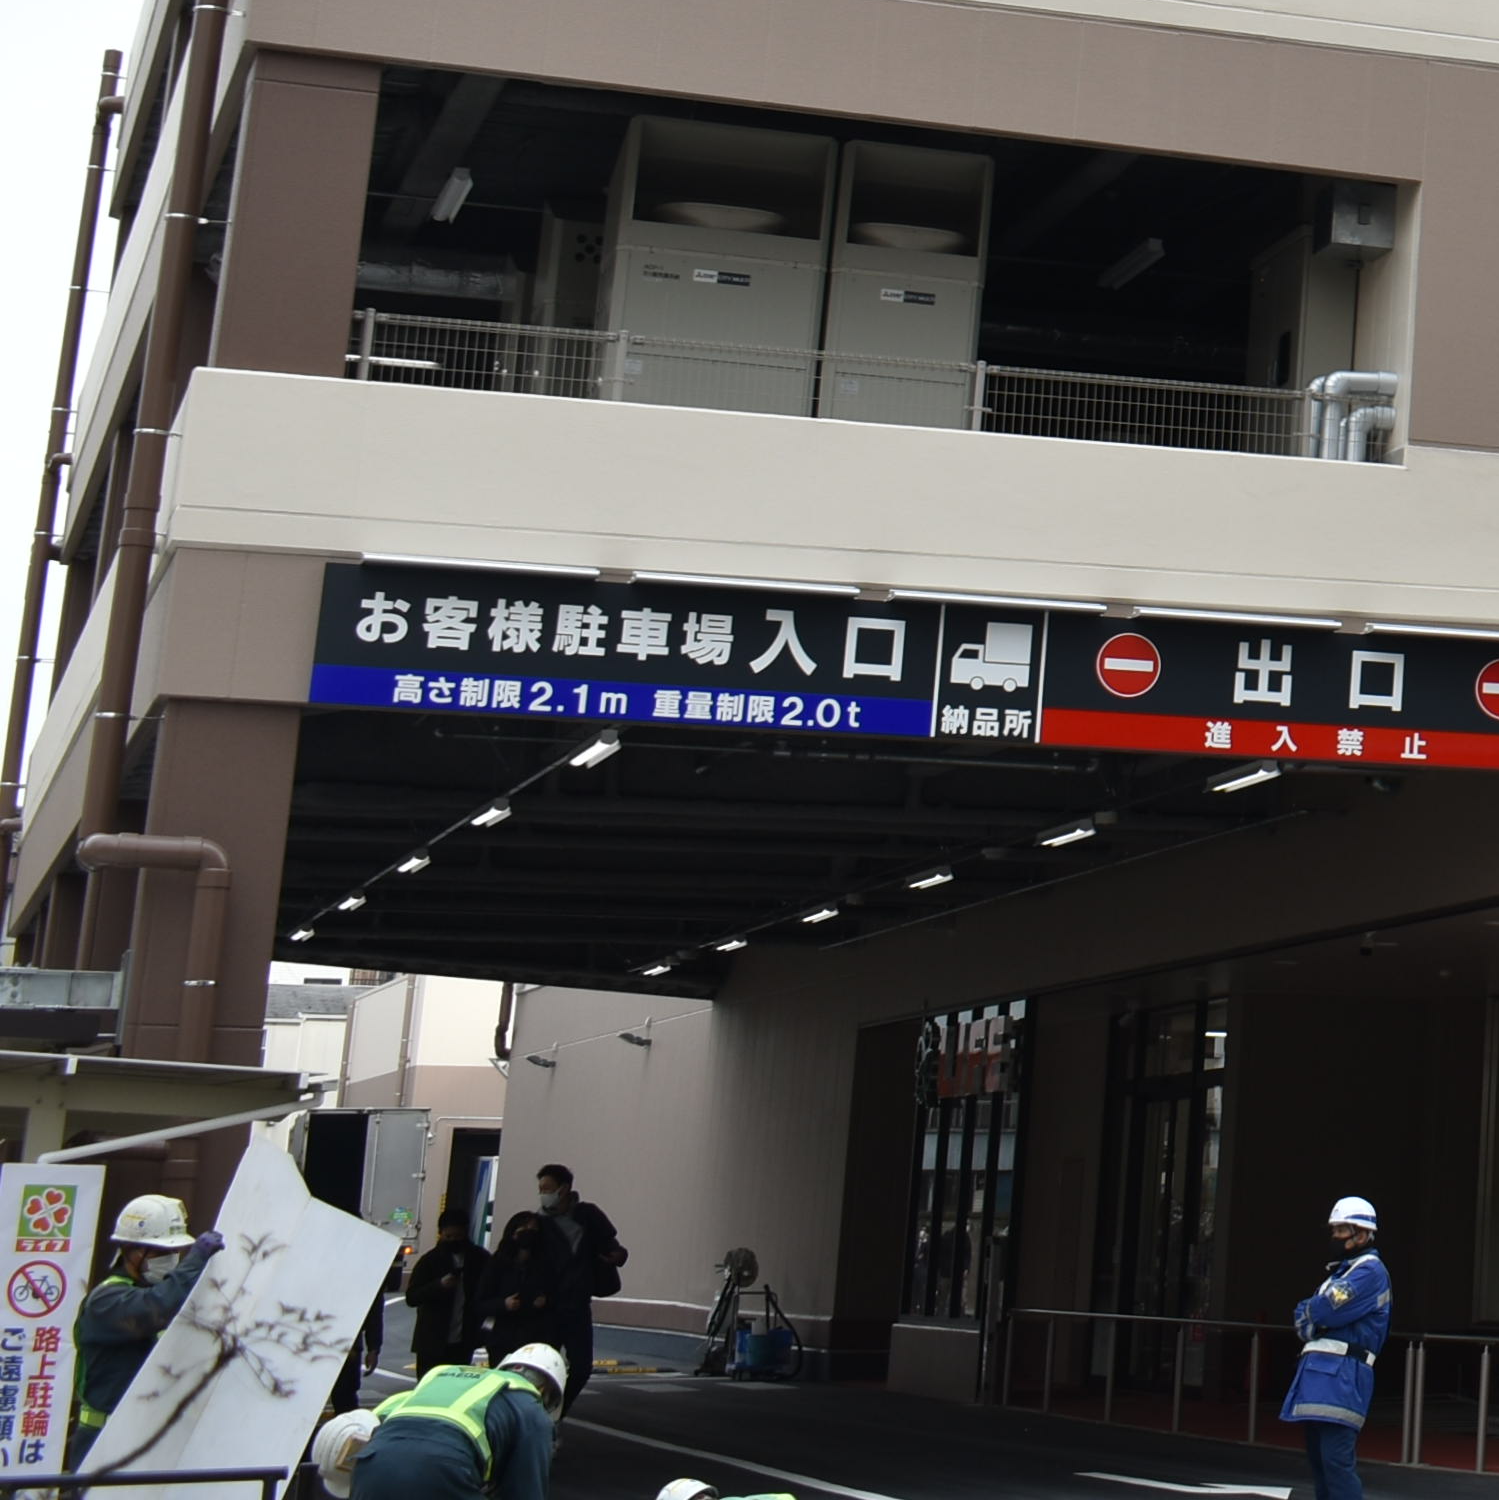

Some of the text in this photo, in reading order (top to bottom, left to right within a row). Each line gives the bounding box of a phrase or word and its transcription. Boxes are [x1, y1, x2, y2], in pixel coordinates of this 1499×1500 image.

[393, 674, 861, 729] 高さ制限2.1m 重量制限2.0t
[941, 704, 1032, 738] 納品所
[20, 1239, 68, 1252] ライフ
[18, 1327, 62, 1465] 路上駐輪は
